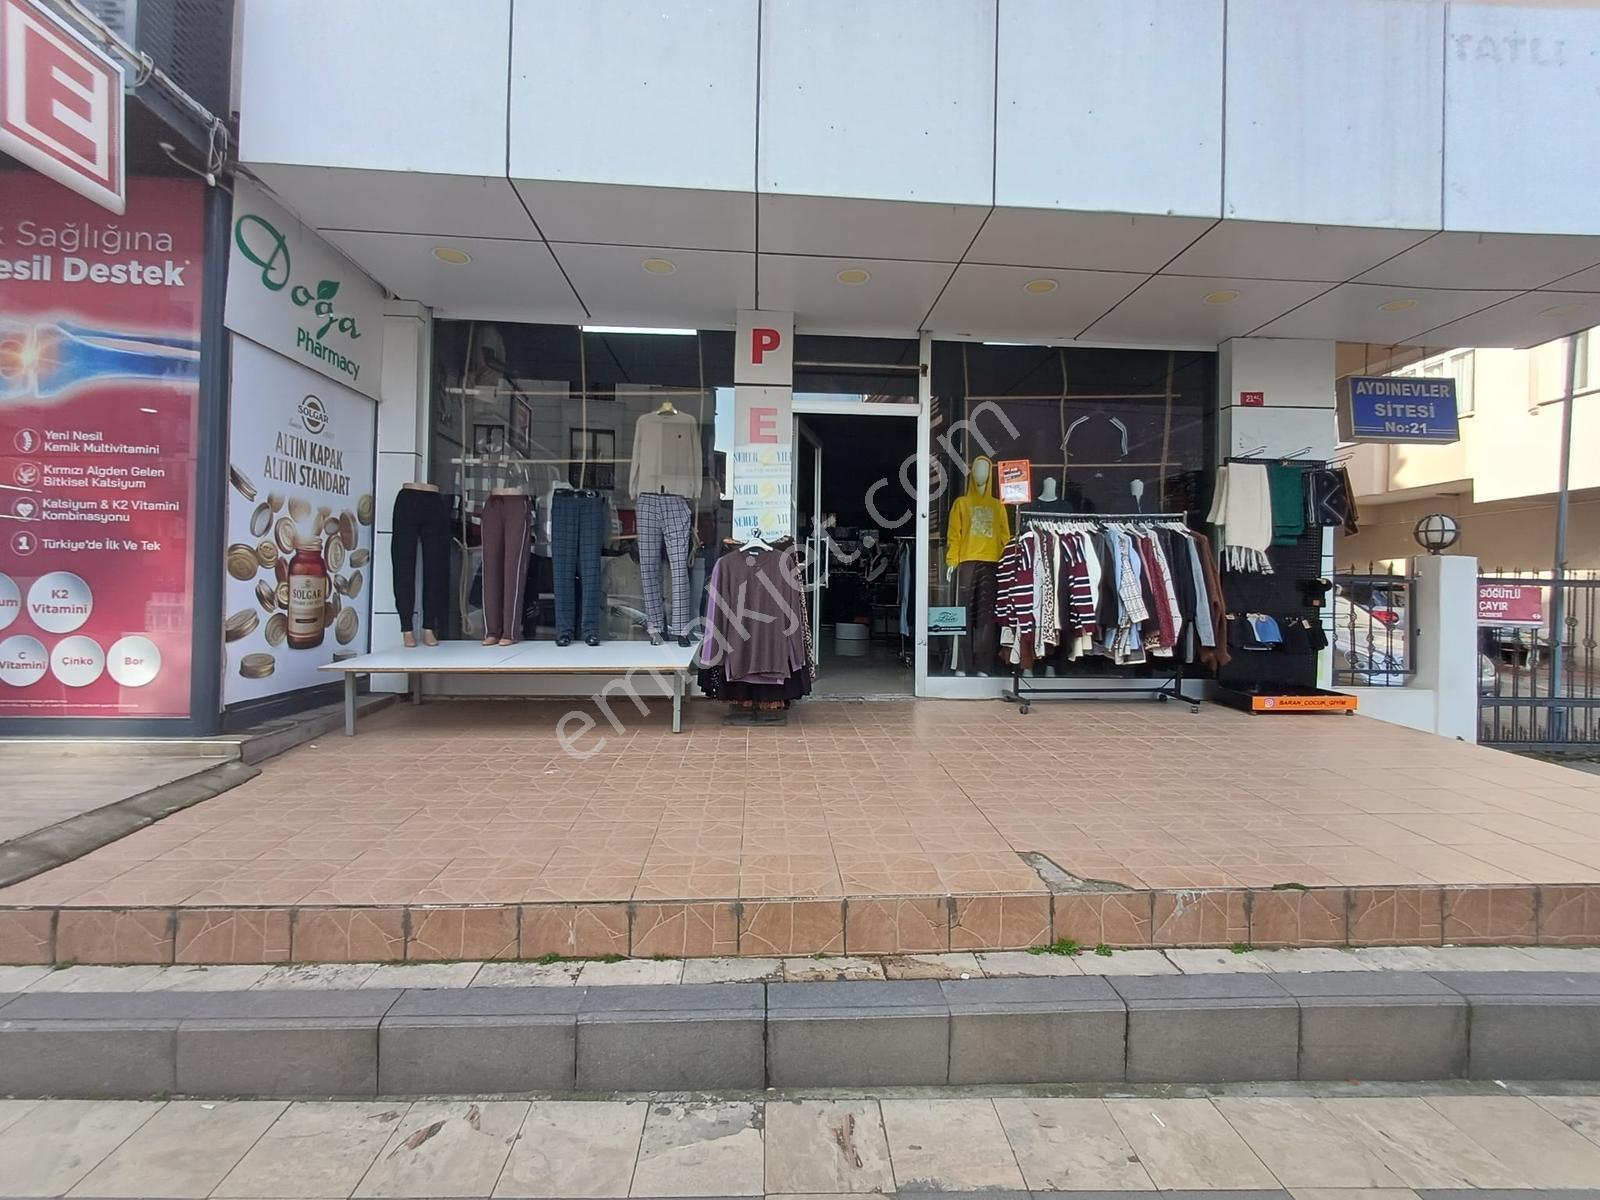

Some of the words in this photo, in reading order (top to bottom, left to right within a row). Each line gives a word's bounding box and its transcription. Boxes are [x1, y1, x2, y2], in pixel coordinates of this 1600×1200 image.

[17, 220, 173, 254] Sağlığına
[0, 256, 51, 281] esil
[297, 327, 360, 381] Pharmacy
[1356, 381, 1450, 398] AYDINEVLER
[297, 404, 329, 424] SOLGAR
[1375, 401, 1435, 418] SİTESİ
[1385, 422, 1428, 434] No:21
[45, 430, 70, 440] Yeni
[73, 431, 103, 441] Nesil
[44, 442, 81, 453] Kemik
[83, 443, 160, 454] Multivitamini
[276, 431, 307, 461] ALTIN
[310, 441, 343, 471] KAPAK
[44, 465, 84, 475] Kırmızı
[87, 466, 128, 478] Algden
[131, 466, 165, 477] Gelen
[264, 455, 297, 485] ALTIN
[299, 465, 351, 497] STANDART
[43, 477, 89, 487] Bitkisel
[92, 478, 146, 490] Kalsiyum
[42, 499, 97, 511] Kalsiyum
[100, 500, 110, 509] &
[112, 500, 129, 510] K2
[131, 500, 180, 511] Vitamini
[42, 511, 130, 524] Kombinasyonu
[42, 538, 103, 551] Türkiye'de
[105, 538, 120, 550] İlk
[123, 540, 138, 550] Ve
[141, 541, 161, 551] Tek
[51, 589, 69, 599] K2
[293, 588, 322, 600] SOLGAR
[32, 603, 87, 615] Vitamini
[18, 651, 27, 660] C
[125, 656, 144, 666] Bor
[0, 661, 46, 669] Vitamini
